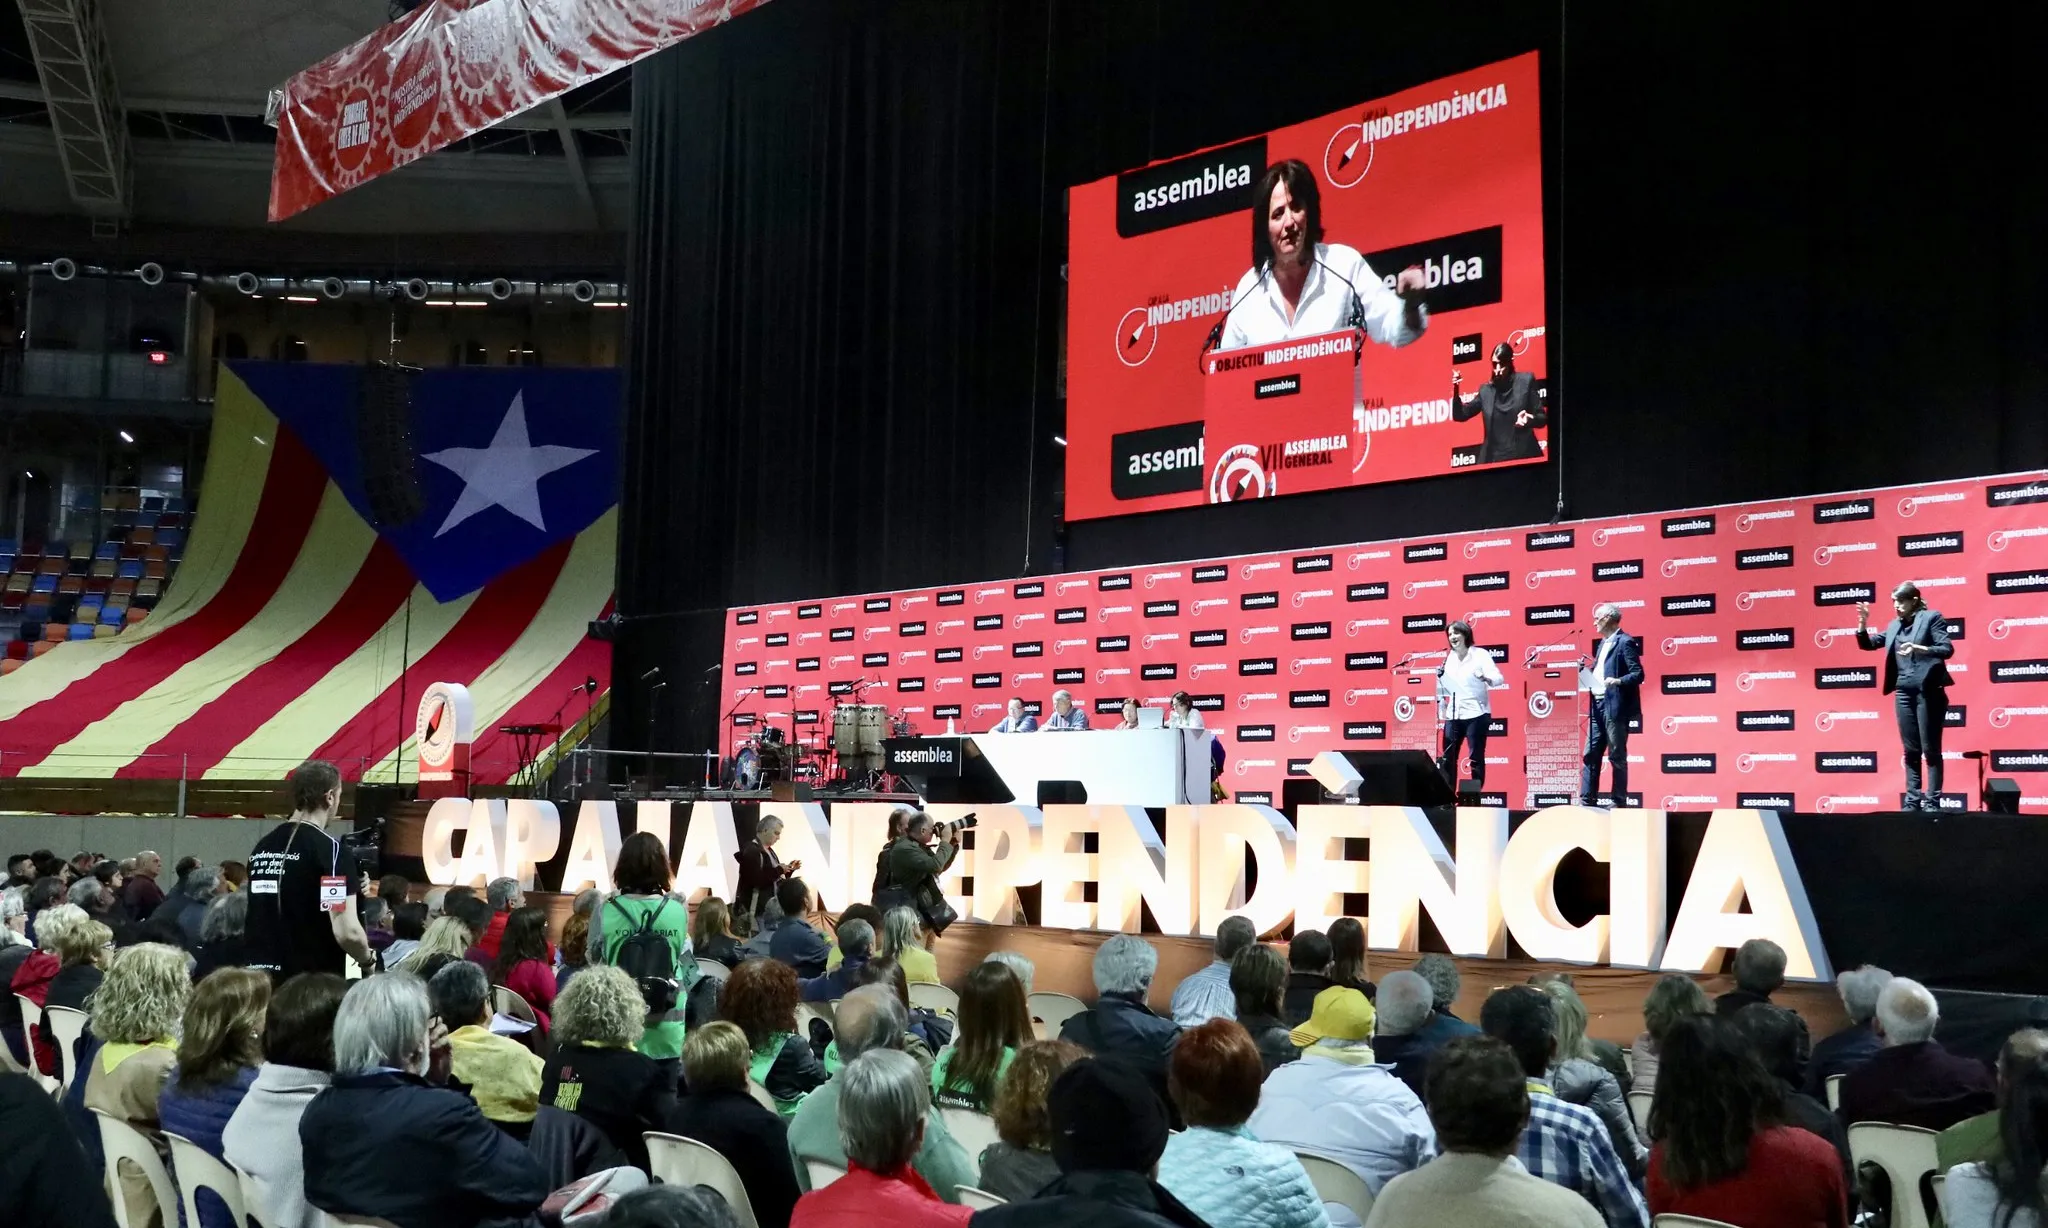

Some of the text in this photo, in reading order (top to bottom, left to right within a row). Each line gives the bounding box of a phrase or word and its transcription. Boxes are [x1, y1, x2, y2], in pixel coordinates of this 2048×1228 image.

[1362, 83, 1508, 144] INDEPENDÈNCIA
[1134, 163, 1251, 212] assemblea
[1147, 285, 1236, 327] INDEPENDÈ
[1259, 379, 1297, 394] assemblea
[1358, 398, 1453, 434] INDEPEND
[1128, 437, 1204, 475] assem
[1261, 434, 1347, 471] VII ASSEMBLEA
[1284, 451, 1333, 469] GENERAL
[1820, 504, 1869, 517] assemblea
[1667, 520, 1711, 532] assemblea
[1531, 534, 1570, 546] assemblea
[1905, 537, 1958, 550] assemblea
[1408, 547, 1444, 558] assemblea
[1742, 551, 1789, 564] assemblea
[1296, 558, 1330, 569] assemblea
[1195, 569, 1226, 579] assemblea
[1597, 564, 1639, 576] assemblea
[1102, 577, 1130, 587] assemblea
[1468, 575, 1506, 587] assemblea
[1351, 586, 1385, 597] assemblea
[1820, 587, 1870, 598] assemblea
[1244, 595, 1276, 605] assemblea
[1667, 598, 1711, 610] assemblea
[1147, 603, 1176, 613] assemblea
[1530, 609, 1570, 620] assemblea
[1407, 617, 1443, 628] assemblea
[1295, 626, 1328, 636] assemblea
[1194, 633, 1224, 642] assemblea
[1742, 633, 1789, 644] assemblea
[1099, 639, 1127, 648] assemblea
[1243, 661, 1274, 671] assemblea
[1349, 656, 1384, 665] assemblea
[1144, 667, 1174, 676] assemblea
[1821, 671, 1871, 683] assemblea
[1667, 678, 1712, 689] assemblea
[1293, 694, 1326, 703] assemblea
[1098, 701, 1123, 709] assemble
[1742, 714, 1790, 725] assemblea
[1240, 728, 1272, 737] assemblea
[1348, 725, 1382, 734] assemblea
[894, 746, 953, 763] assemblea
[1998, 754, 2048, 765] assemble
[1667, 757, 1712, 768] assemblea
[1821, 756, 1872, 766] assemblea
[1239, 794, 1270, 803] assemblea
[1742, 797, 1790, 807] assemblea
[422, 797, 561, 893] CAP
[561, 800, 626, 894] A
